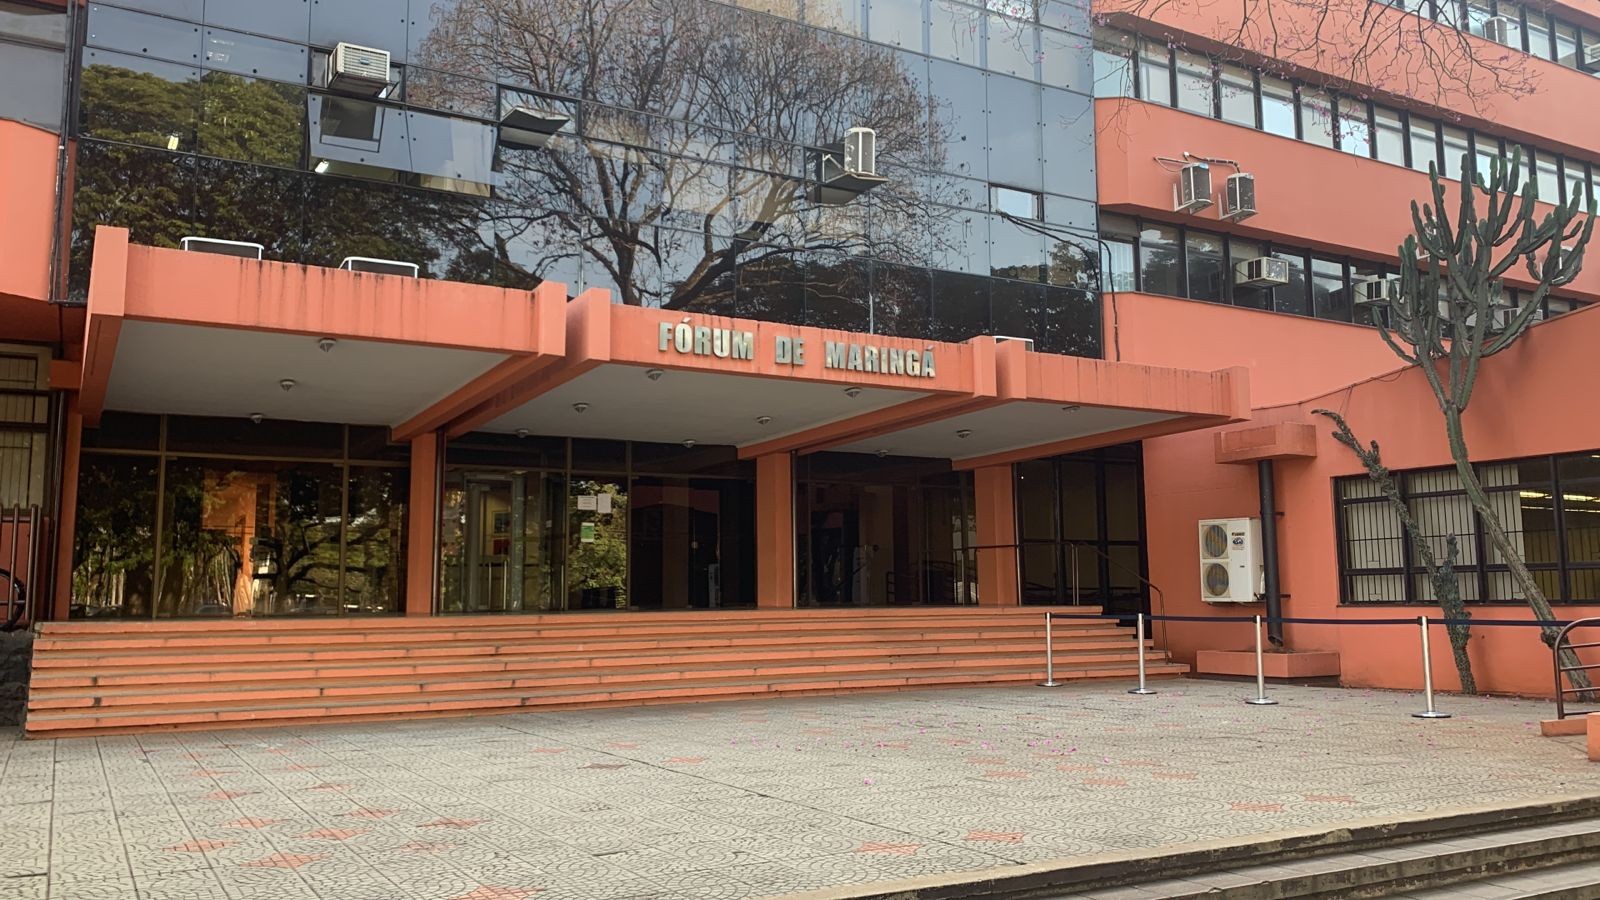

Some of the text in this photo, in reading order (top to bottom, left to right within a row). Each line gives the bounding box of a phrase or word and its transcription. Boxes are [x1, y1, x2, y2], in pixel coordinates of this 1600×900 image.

[658, 317, 936, 378] FÓRUM DE MARINGÁ
